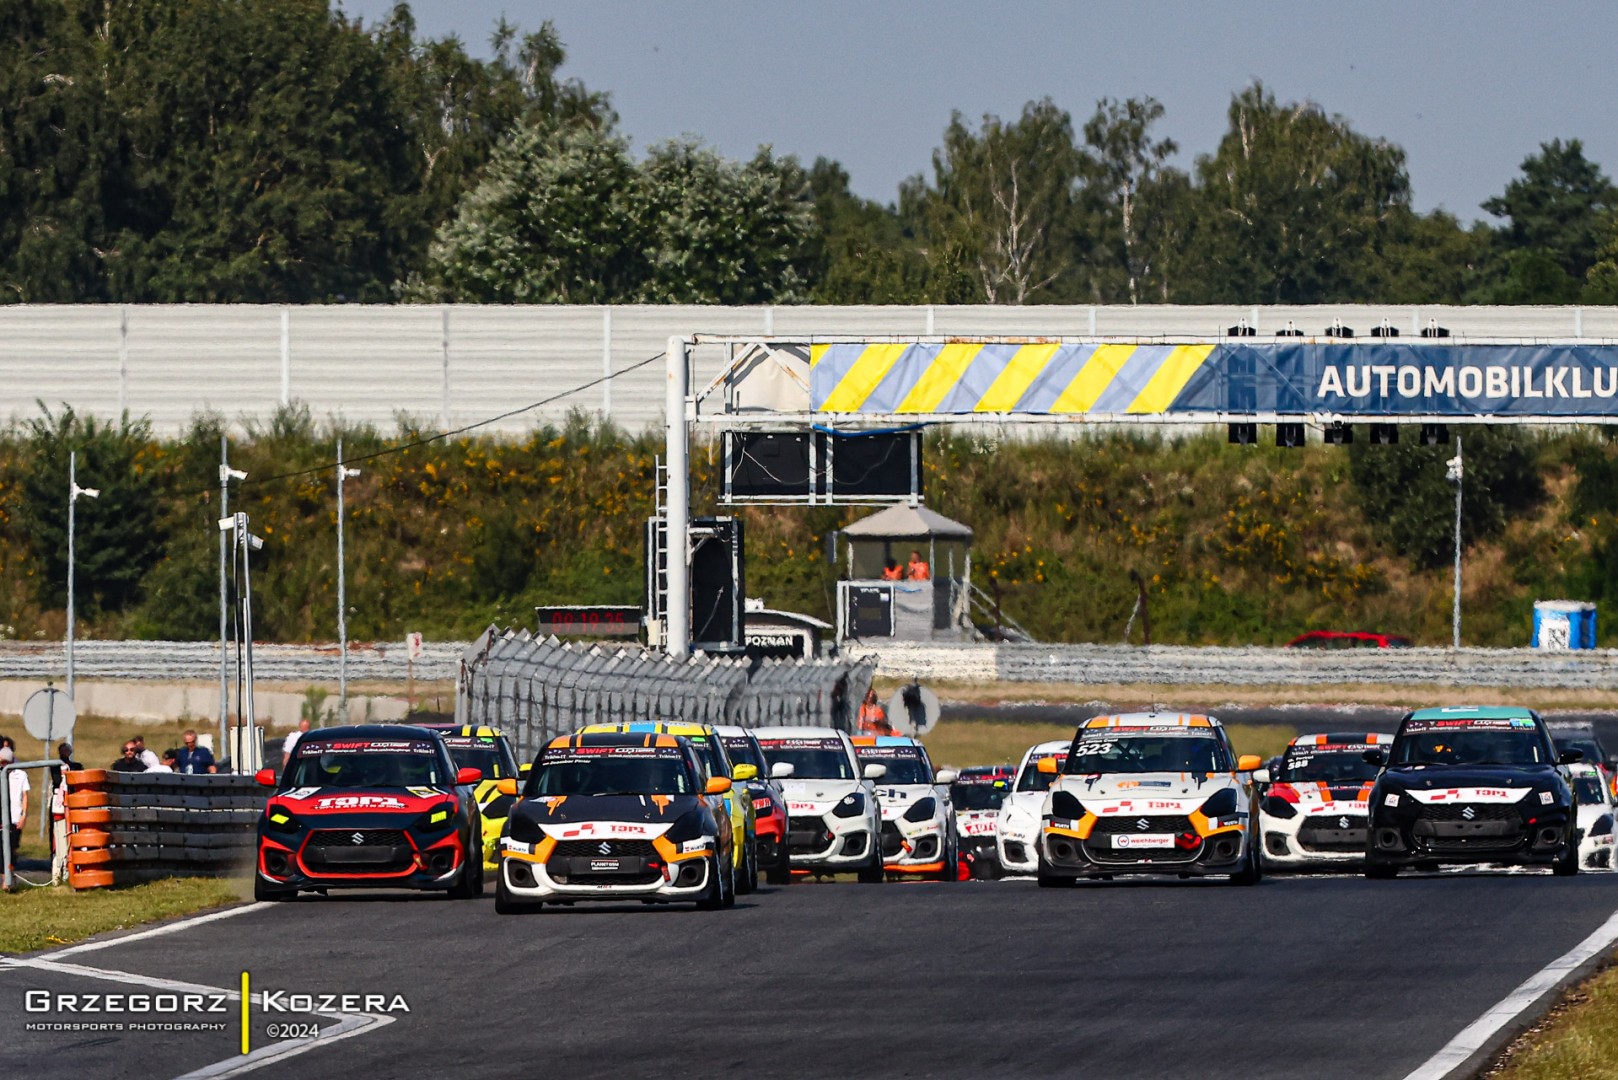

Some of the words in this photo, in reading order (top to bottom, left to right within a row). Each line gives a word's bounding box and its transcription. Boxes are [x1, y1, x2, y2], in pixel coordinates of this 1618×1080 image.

[332, 742, 371, 750] SWIFT
[1075, 743, 1113, 757] 523
[1287, 760, 1309, 770] 588
[317, 796, 406, 807] TOP1
